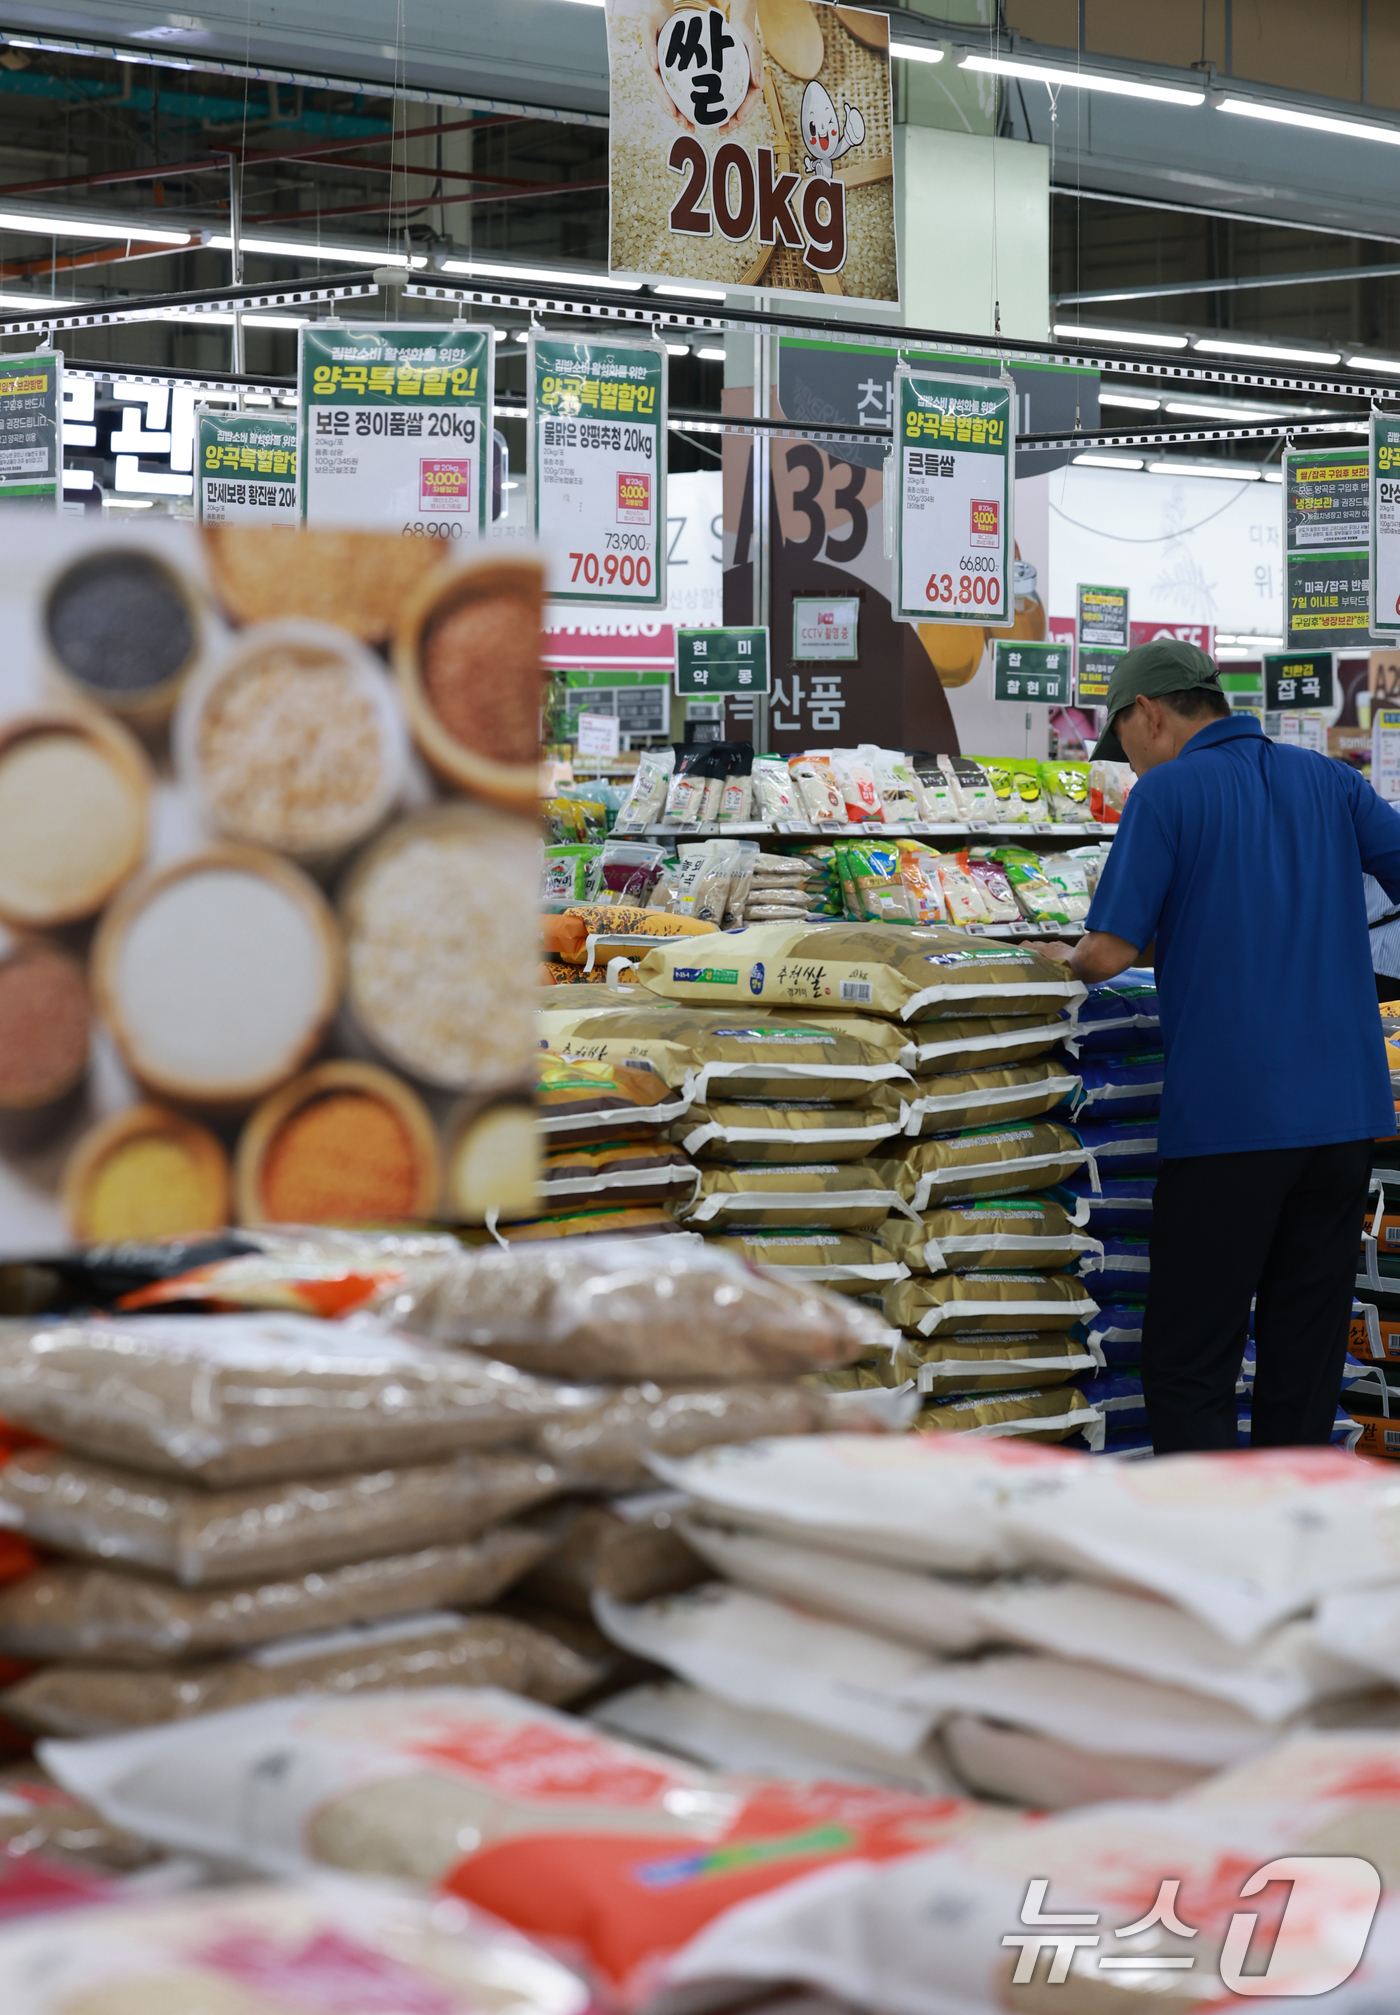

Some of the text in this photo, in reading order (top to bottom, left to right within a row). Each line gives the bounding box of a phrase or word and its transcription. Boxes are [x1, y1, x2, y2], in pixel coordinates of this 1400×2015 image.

[665, 10, 734, 125] 쌀
[668, 136, 846, 272] 20kg
[332, 347, 467, 362] 집밥소비 활성화를 위한
[313, 365, 478, 396] 양곡특별할인
[555, 358, 590, 375] 집밥소비
[629, 365, 647, 381] 위한
[541, 376, 655, 414] 양곡특별할인
[316, 411, 476, 444] 보은 정이품쌀 20kg
[906, 411, 1004, 445] 양곡특별할인
[544, 421, 652, 460] 물맑은 양평추청 20kg
[315, 457, 358, 466] 100g/345원
[908, 452, 955, 478] 큰들쌀
[1301, 470, 1326, 480] 쌀/잡곡
[1328, 469, 1350, 478] 구입후
[207, 482, 246, 505] 만세보령
[248, 484, 277, 507] 황진쌀
[1315, 484, 1336, 494] 양곡은
[1337, 483, 1359, 493] 구입후
[1361, 482, 1369, 492] 반
[1296, 497, 1340, 510] 냉장보관을
[402, 522, 463, 540] 68,900
[604, 532, 646, 551] 73,900
[569, 552, 651, 587] 70,900
[960, 555, 996, 572] 66,800
[926, 573, 1000, 606] 63,800
[1305, 580, 1348, 593] 미곡/잡곡
[1291, 597, 1307, 609] 7일
[1310, 595, 1339, 608] 이내로
[802, 628, 823, 639] CCTV
[841, 627, 849, 640] 중
[1295, 616, 1319, 627] 구입후
[1375, 664, 1400, 698] A2
[777, 965, 826, 998] 추청쌀
